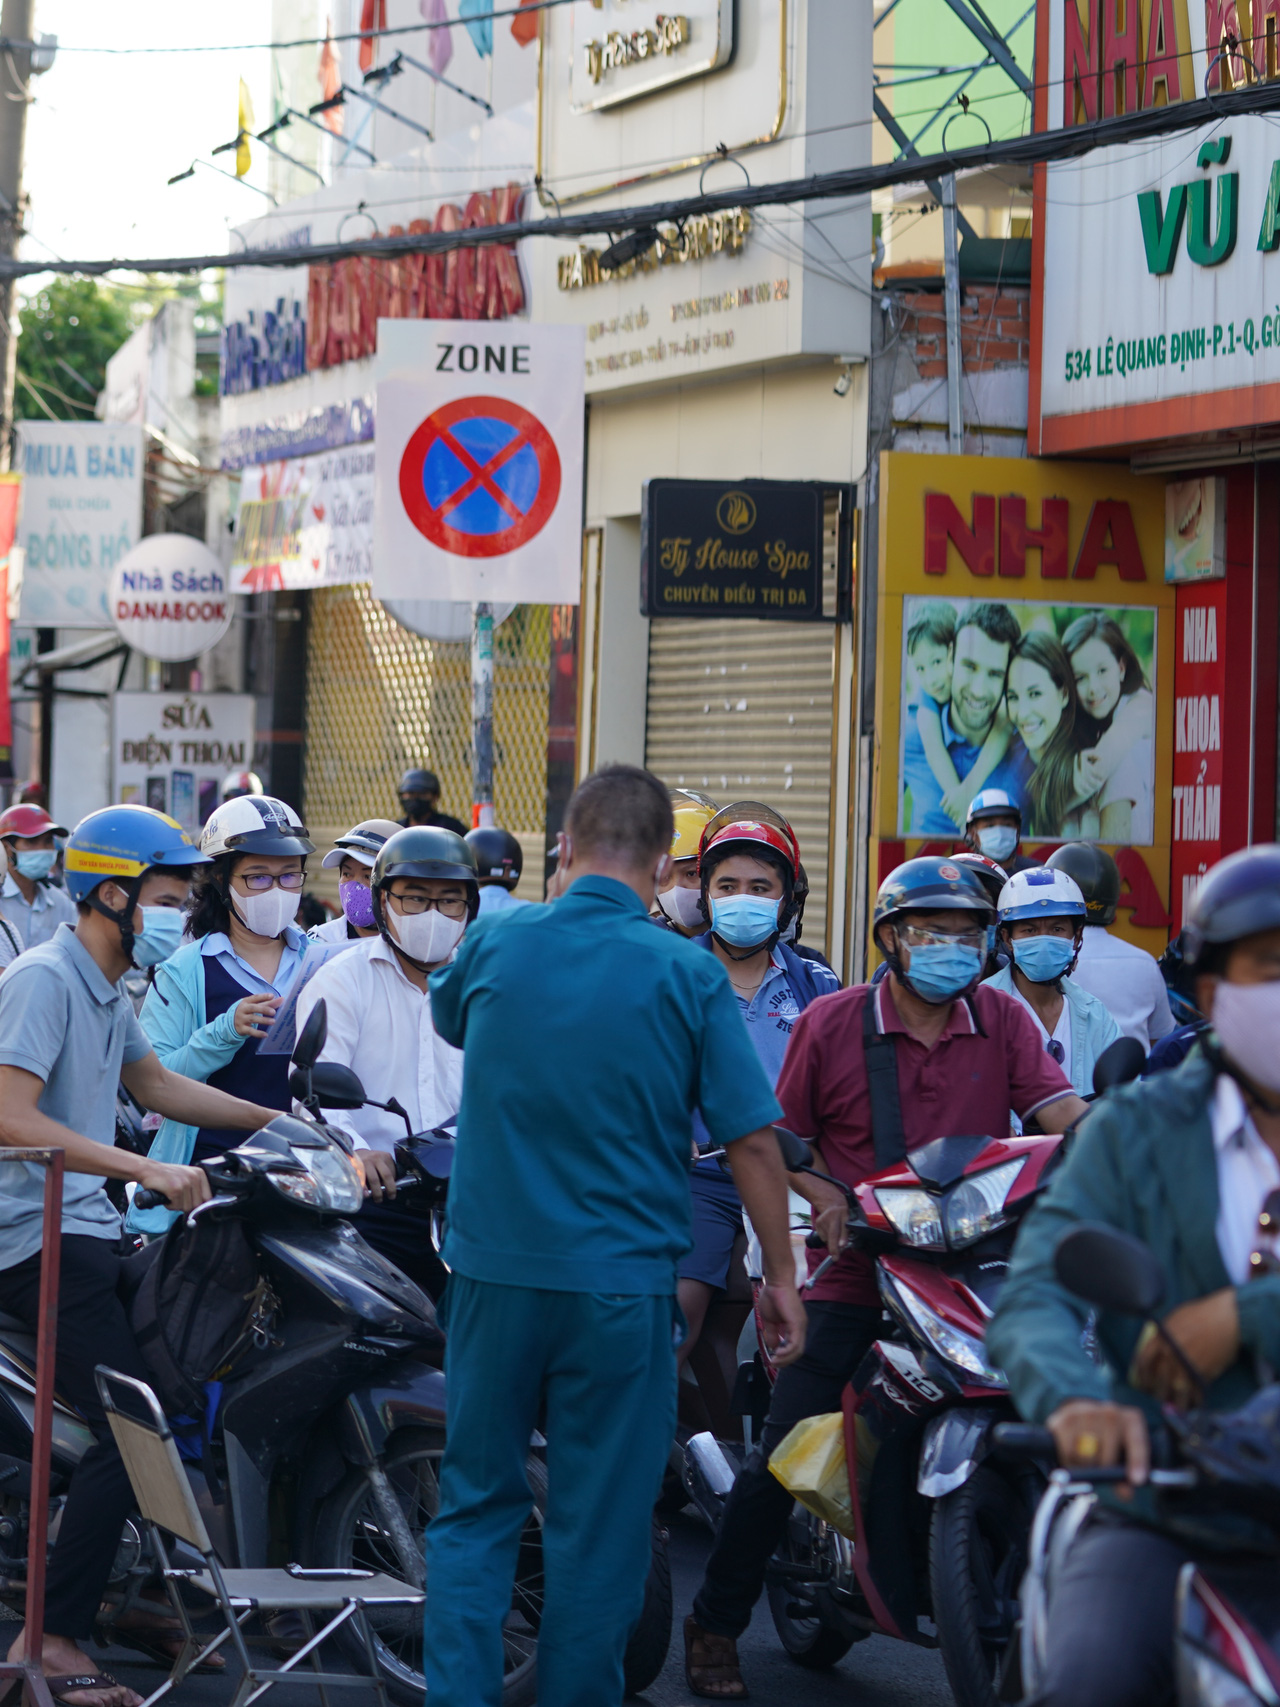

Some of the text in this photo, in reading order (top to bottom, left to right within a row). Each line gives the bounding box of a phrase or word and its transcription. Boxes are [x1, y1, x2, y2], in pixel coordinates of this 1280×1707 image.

[1137, 135, 1239, 275] VŨ
[436, 344, 530, 373] ZONE
[1065, 348, 1091, 382] 534
[1097, 335, 1113, 377] LÊ
[1116, 334, 1166, 378] QUANG
[25, 442, 78, 478] MUA
[924, 493, 1147, 581] NHA
[694, 537, 760, 571] House
[764, 539, 811, 580] Spa
[122, 566, 224, 592] Nhà Sách
[788, 589, 807, 605] DA
[116, 600, 227, 624] DANABOOK
[1183, 606, 1218, 662] NHA
[1175, 695, 1220, 753] KHOA
[1172, 758, 1221, 841] THẨM
[343, 1340, 387, 1357] HONDA
[903, 1369, 939, 1399] 110
